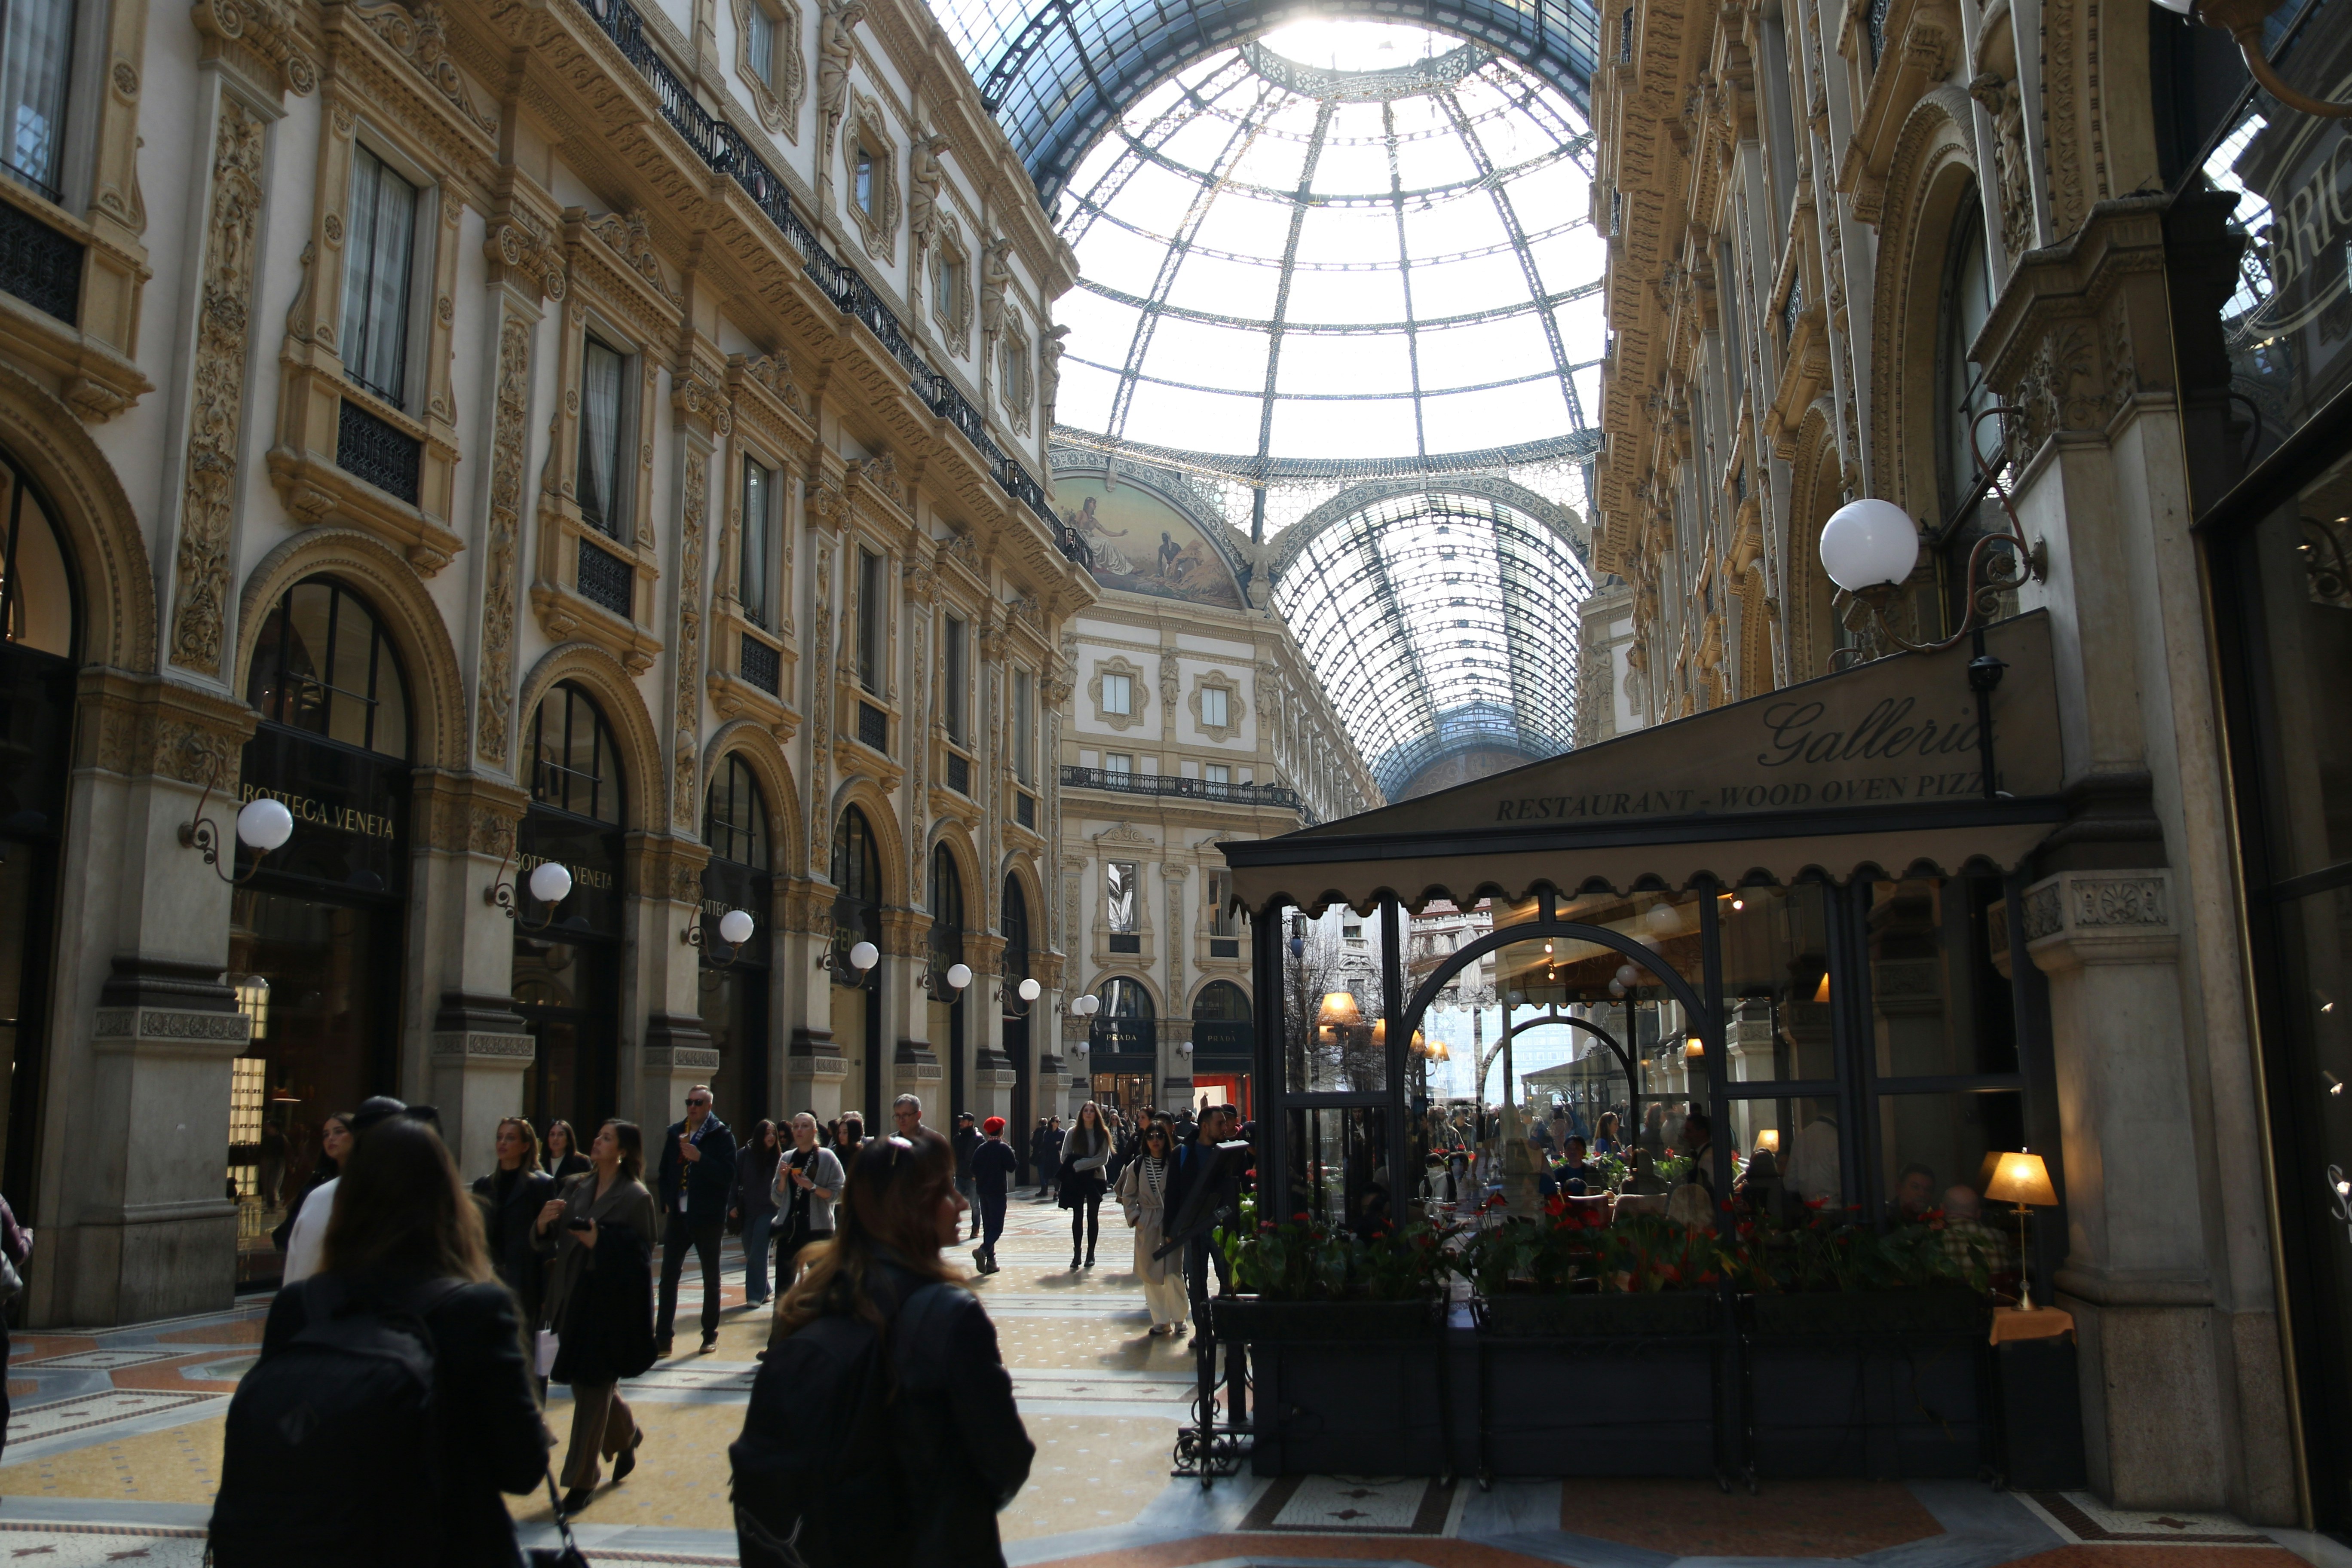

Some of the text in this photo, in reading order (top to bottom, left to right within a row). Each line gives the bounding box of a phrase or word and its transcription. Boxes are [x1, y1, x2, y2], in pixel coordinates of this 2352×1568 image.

[1758, 696, 2000, 766] Galleria
[1495, 789, 1694, 821] RESTAURANT
[1721, 783, 1811, 809] WOOD
[1821, 776, 1908, 802] OVEN
[334, 805, 395, 839] VENETA
[573, 865, 613, 891] VENETA
[1245, 1129, 1251, 1138] LA
